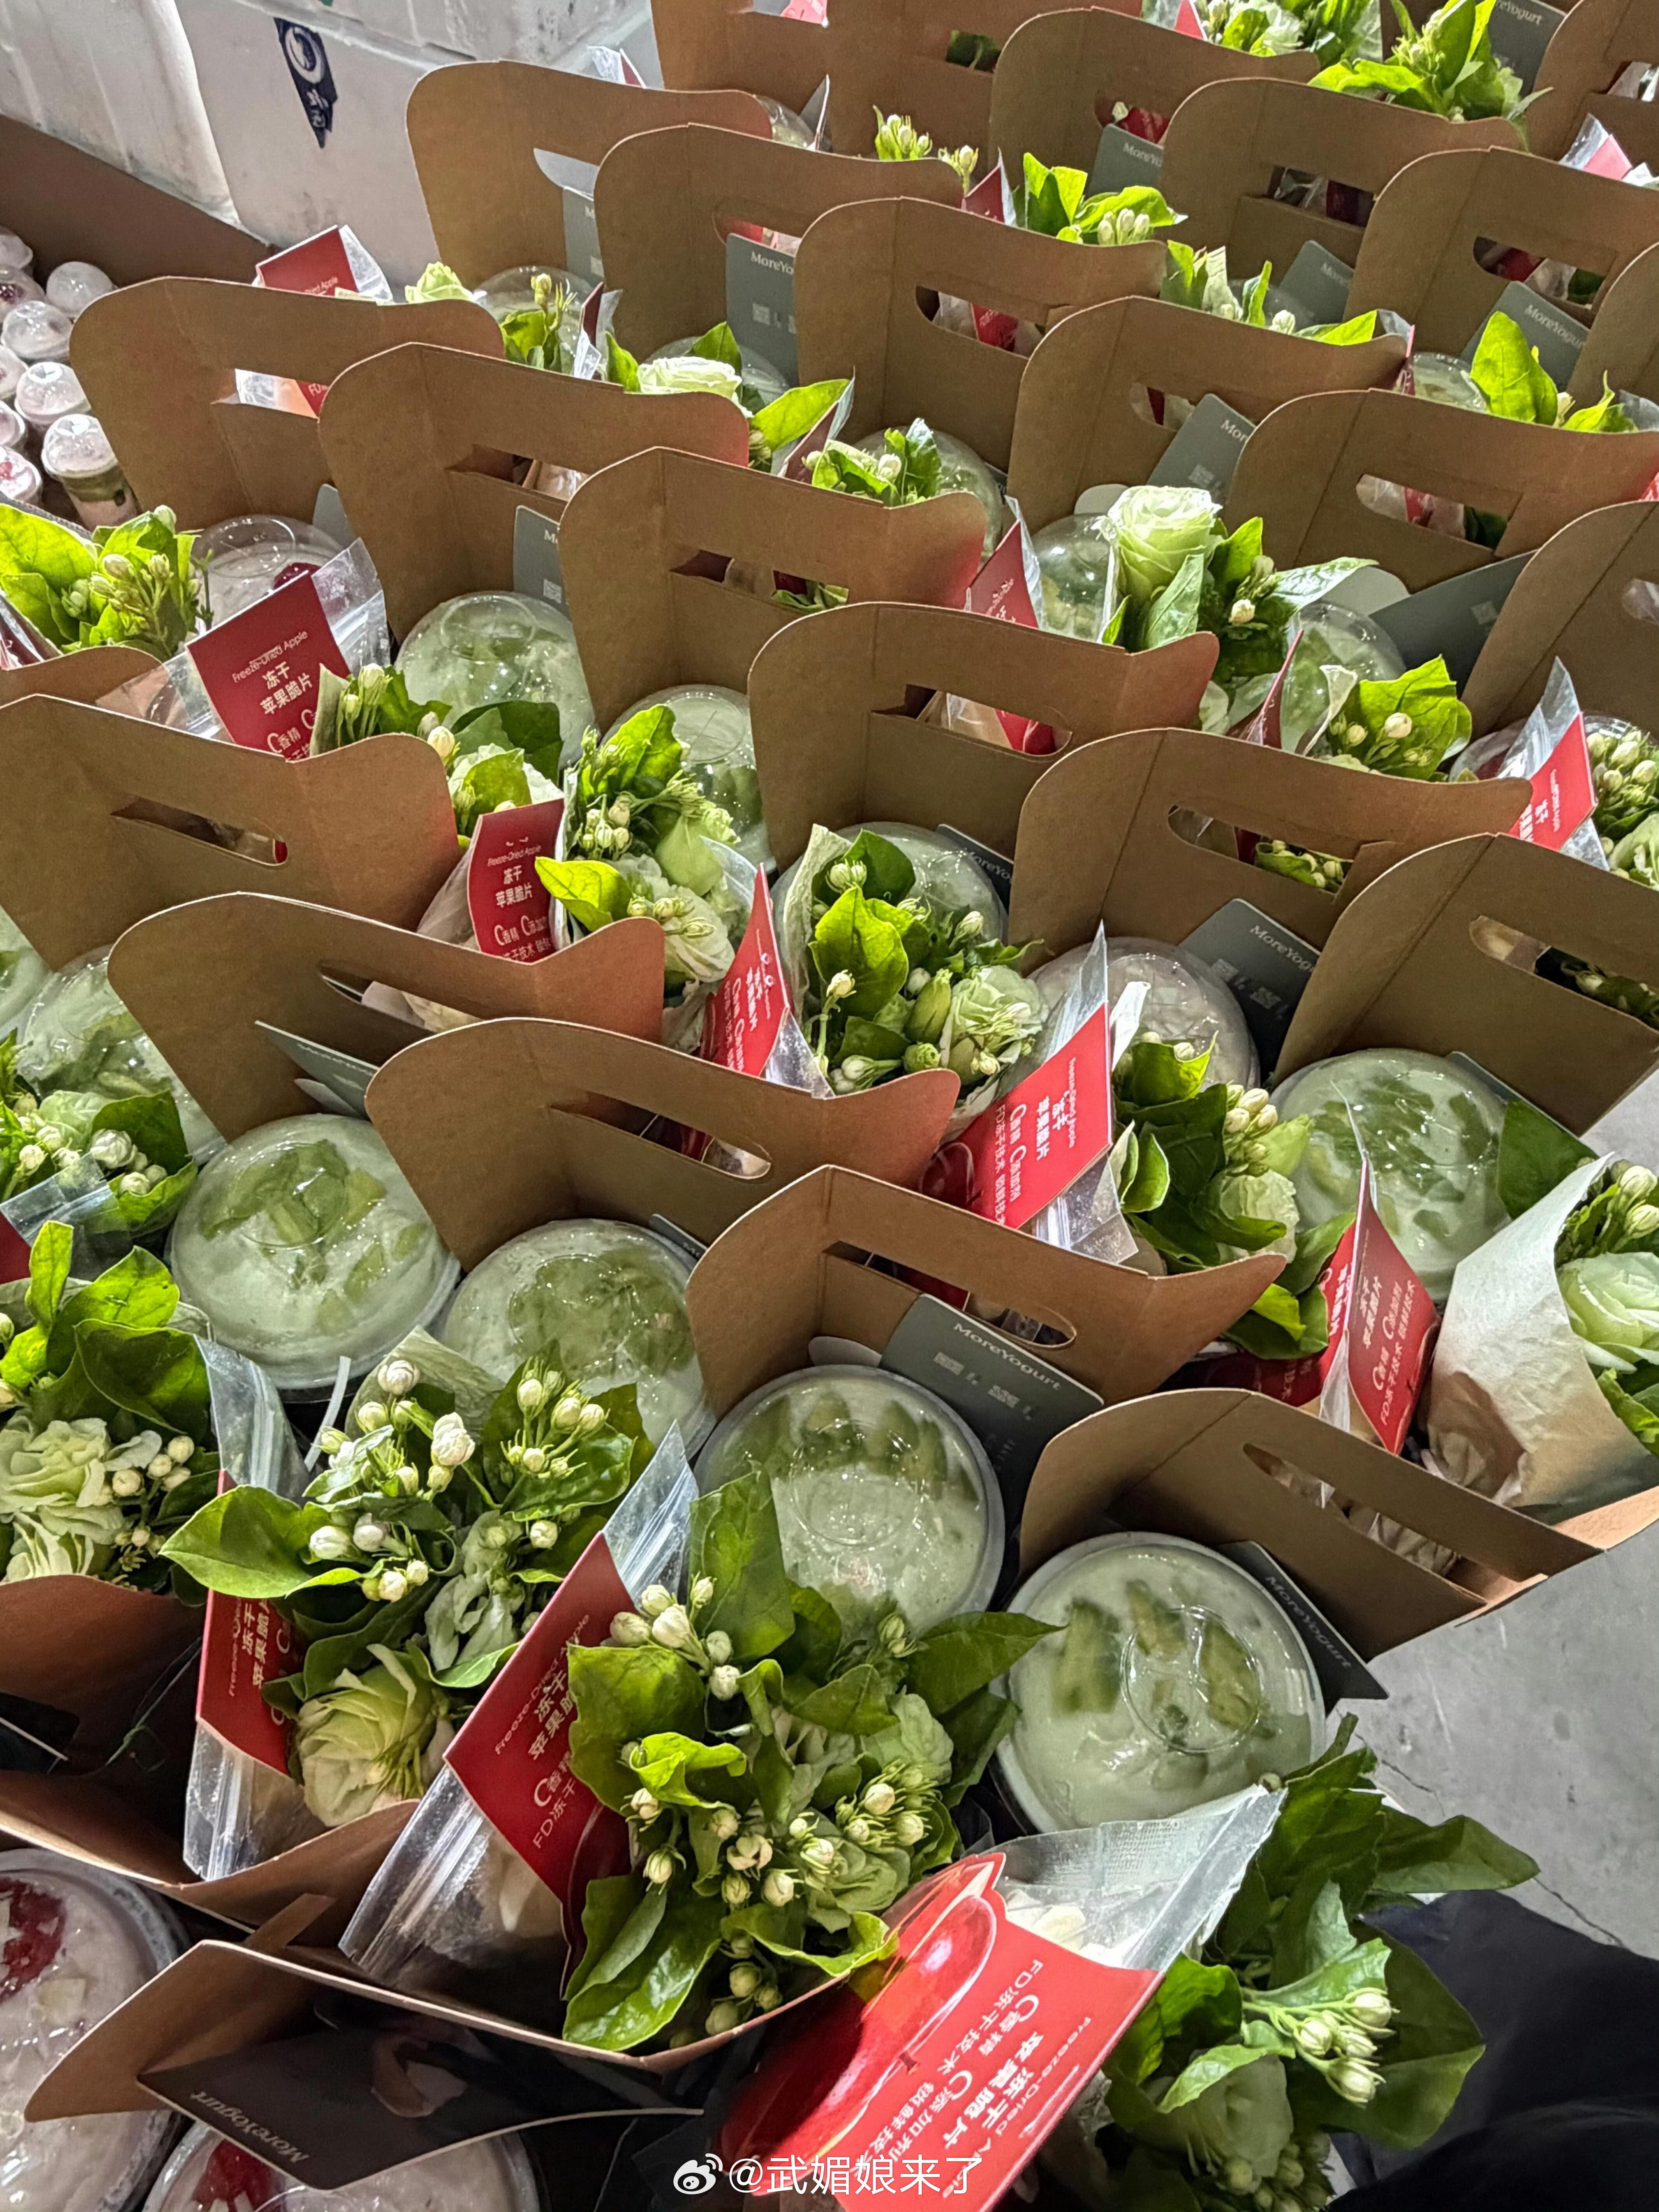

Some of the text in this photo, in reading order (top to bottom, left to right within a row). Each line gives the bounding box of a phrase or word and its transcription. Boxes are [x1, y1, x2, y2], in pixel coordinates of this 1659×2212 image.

[750, 250, 794, 275] MoreYo
[1524, 304, 1583, 349] MoreYogur
[284, 631, 308, 650] Apple
[260, 672, 312, 715] 苹果脆片
[262, 661, 290, 690] 冻干
[968, 852, 1011, 879] oreYo
[1249, 925, 1314, 972] MoreYog
[954, 1323, 1062, 1391] MoreYogurt
[241, 1603, 255, 1656] 冻干
[1265, 1576, 1351, 1668] MoreYogurt
[528, 1690, 573, 1761] 苹果
[533, 1670, 566, 1723] 冻干
[533, 1777, 576, 1850] FD冻干
[937, 1959, 1044, 2076] FD冻干技术
[942, 2031, 1044, 2149] 苹果脆片
[981, 2066, 1034, 2129] 冻干
[995, 2017, 1092, 2136] Freeze-Dried
[190, 2090, 310, 2164] MoreYogurt
